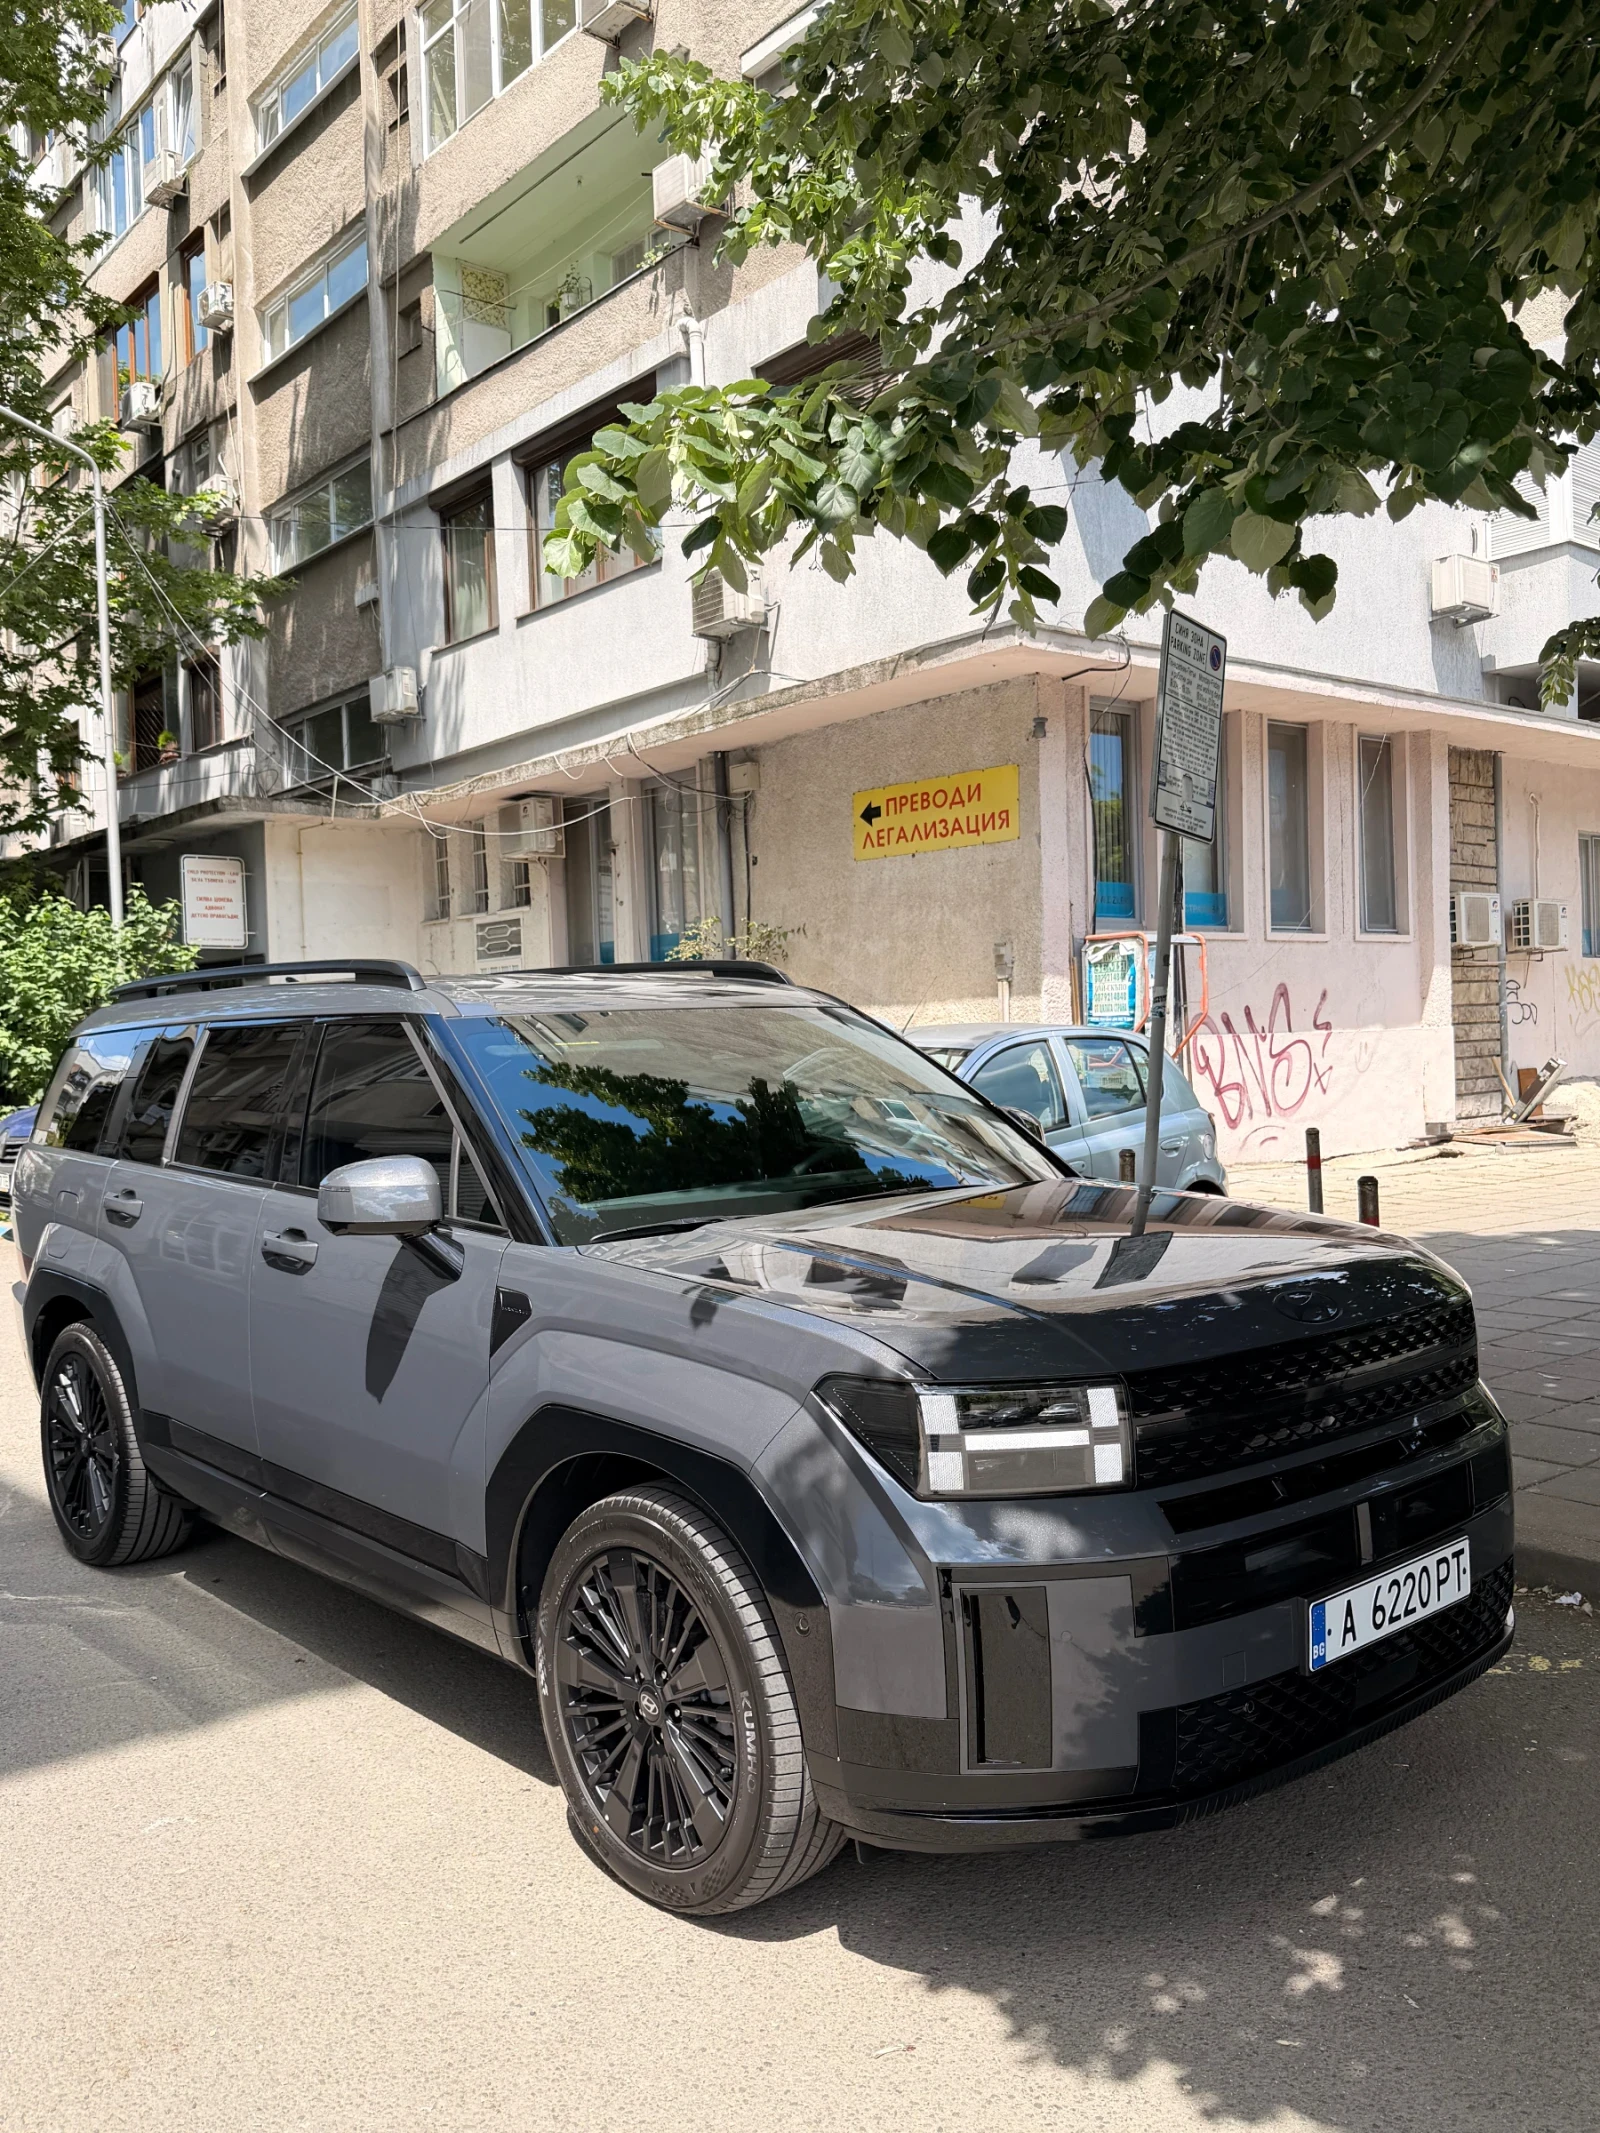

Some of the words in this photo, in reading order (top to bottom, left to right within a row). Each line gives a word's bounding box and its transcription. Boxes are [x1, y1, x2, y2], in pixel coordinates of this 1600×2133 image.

[1170, 636, 1192, 657] PARKING
[1192, 648, 1206, 665] ZONE
[1175, 623, 1189, 640] СИНЯ
[1191, 631, 1204, 648] ЗОНА
[885, 783, 982, 817] ПРЕВОДИ
[862, 809, 1010, 850] ЛЕГАЛИЗАЦИЯ
[1341, 1599, 1357, 1647] A
[1312, 1643, 1325, 1659] BG
[740, 1690, 758, 1794] KUMHO
